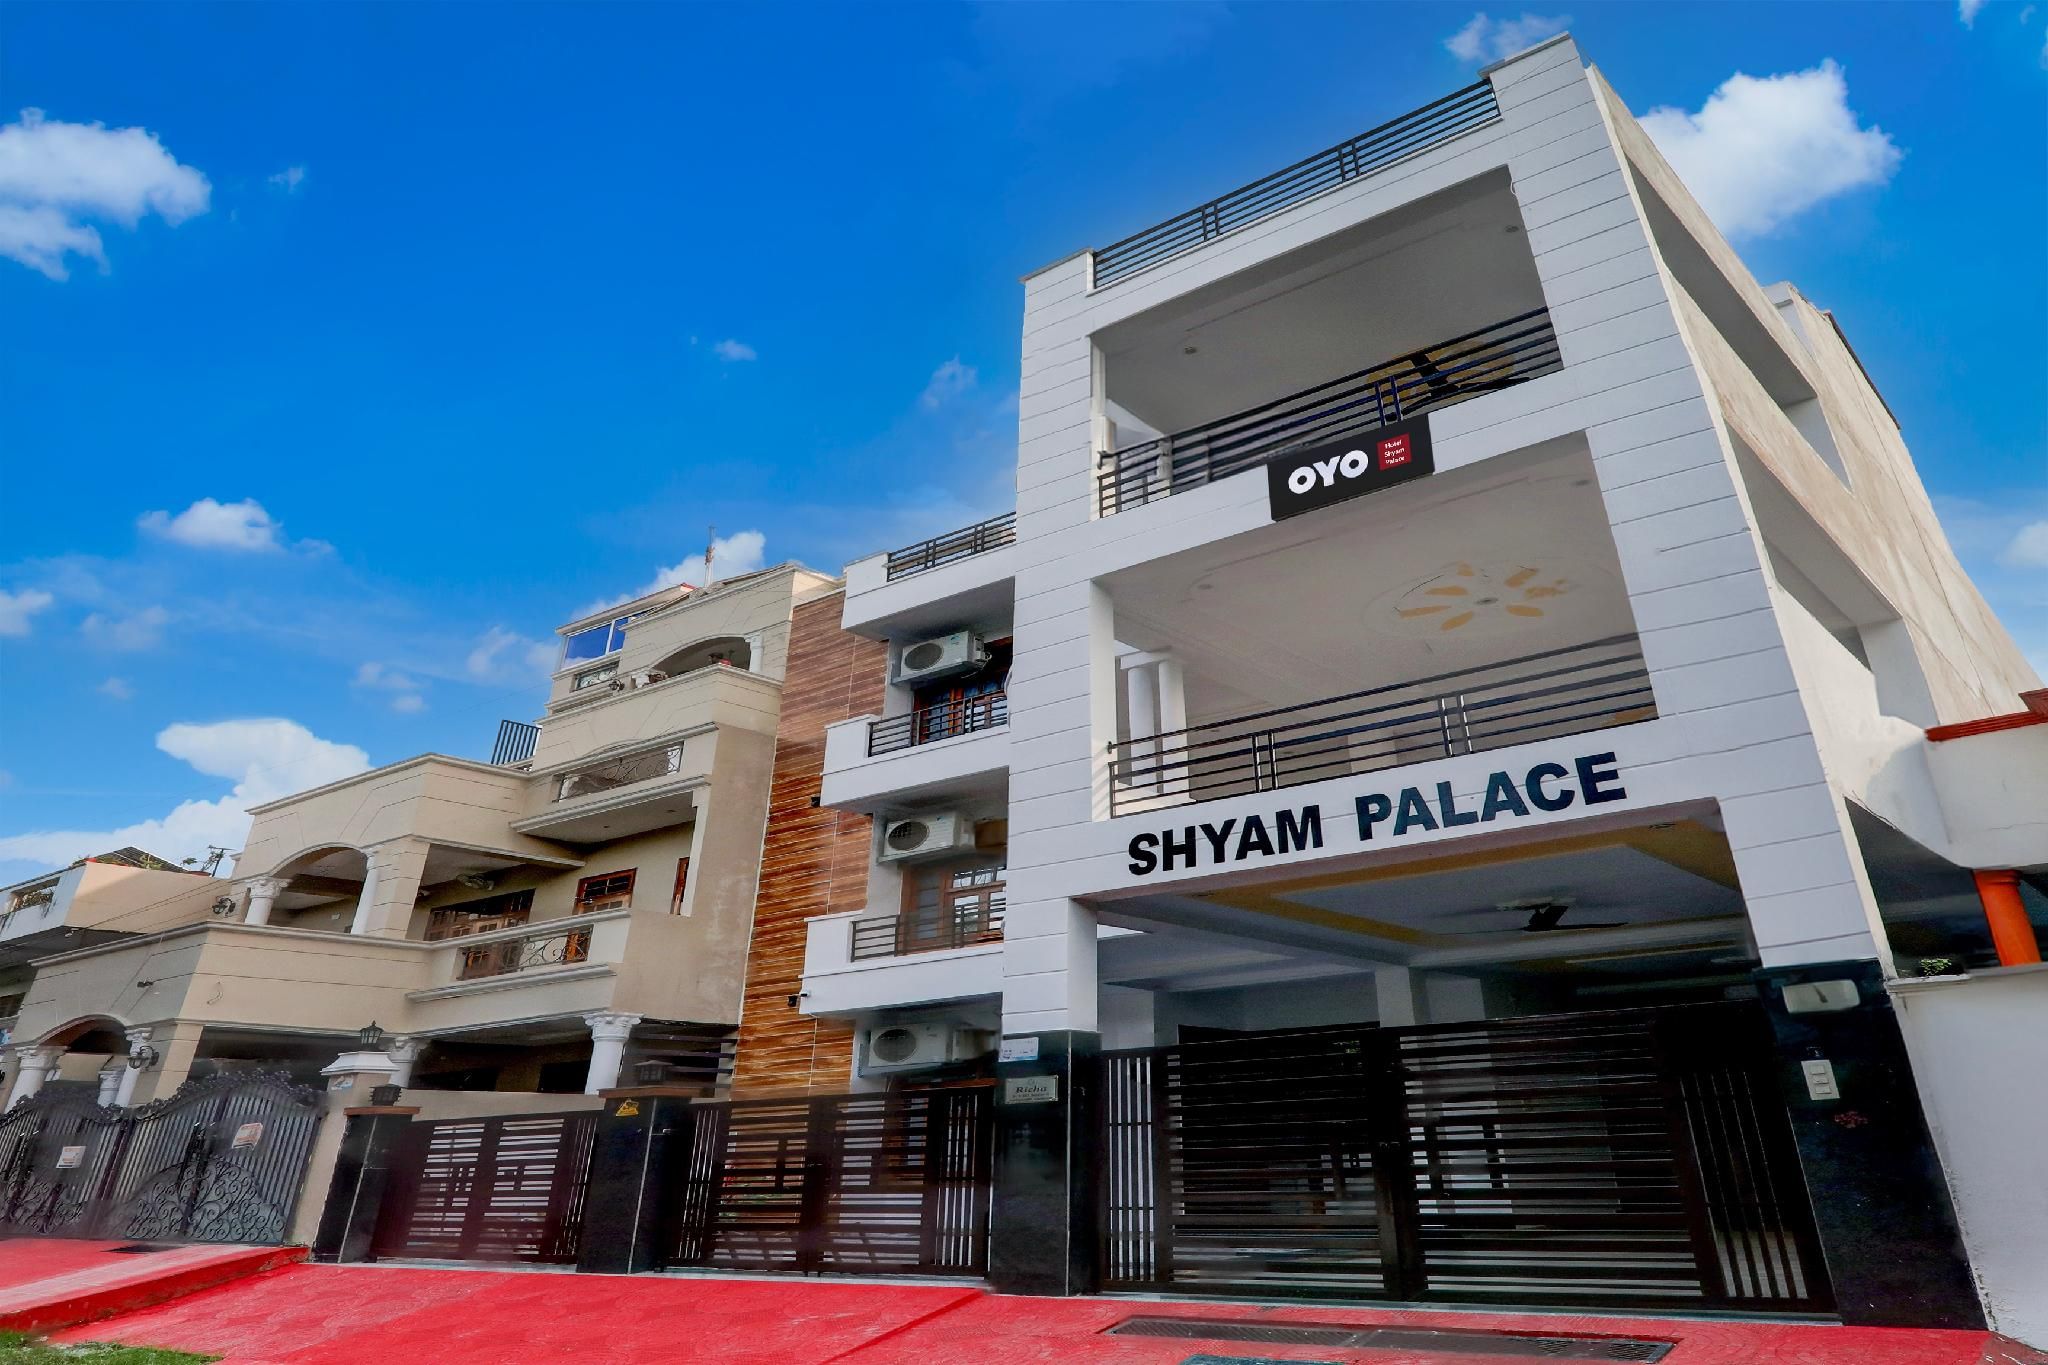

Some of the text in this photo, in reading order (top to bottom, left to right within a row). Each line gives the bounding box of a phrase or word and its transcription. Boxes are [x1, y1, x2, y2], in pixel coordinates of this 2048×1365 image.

[1384, 439, 1402, 449] Hotel
[1384, 447, 1405, 458] Shyam
[1288, 449, 1369, 495] OYO
[1128, 751, 1628, 876] SHYAM PALACE
